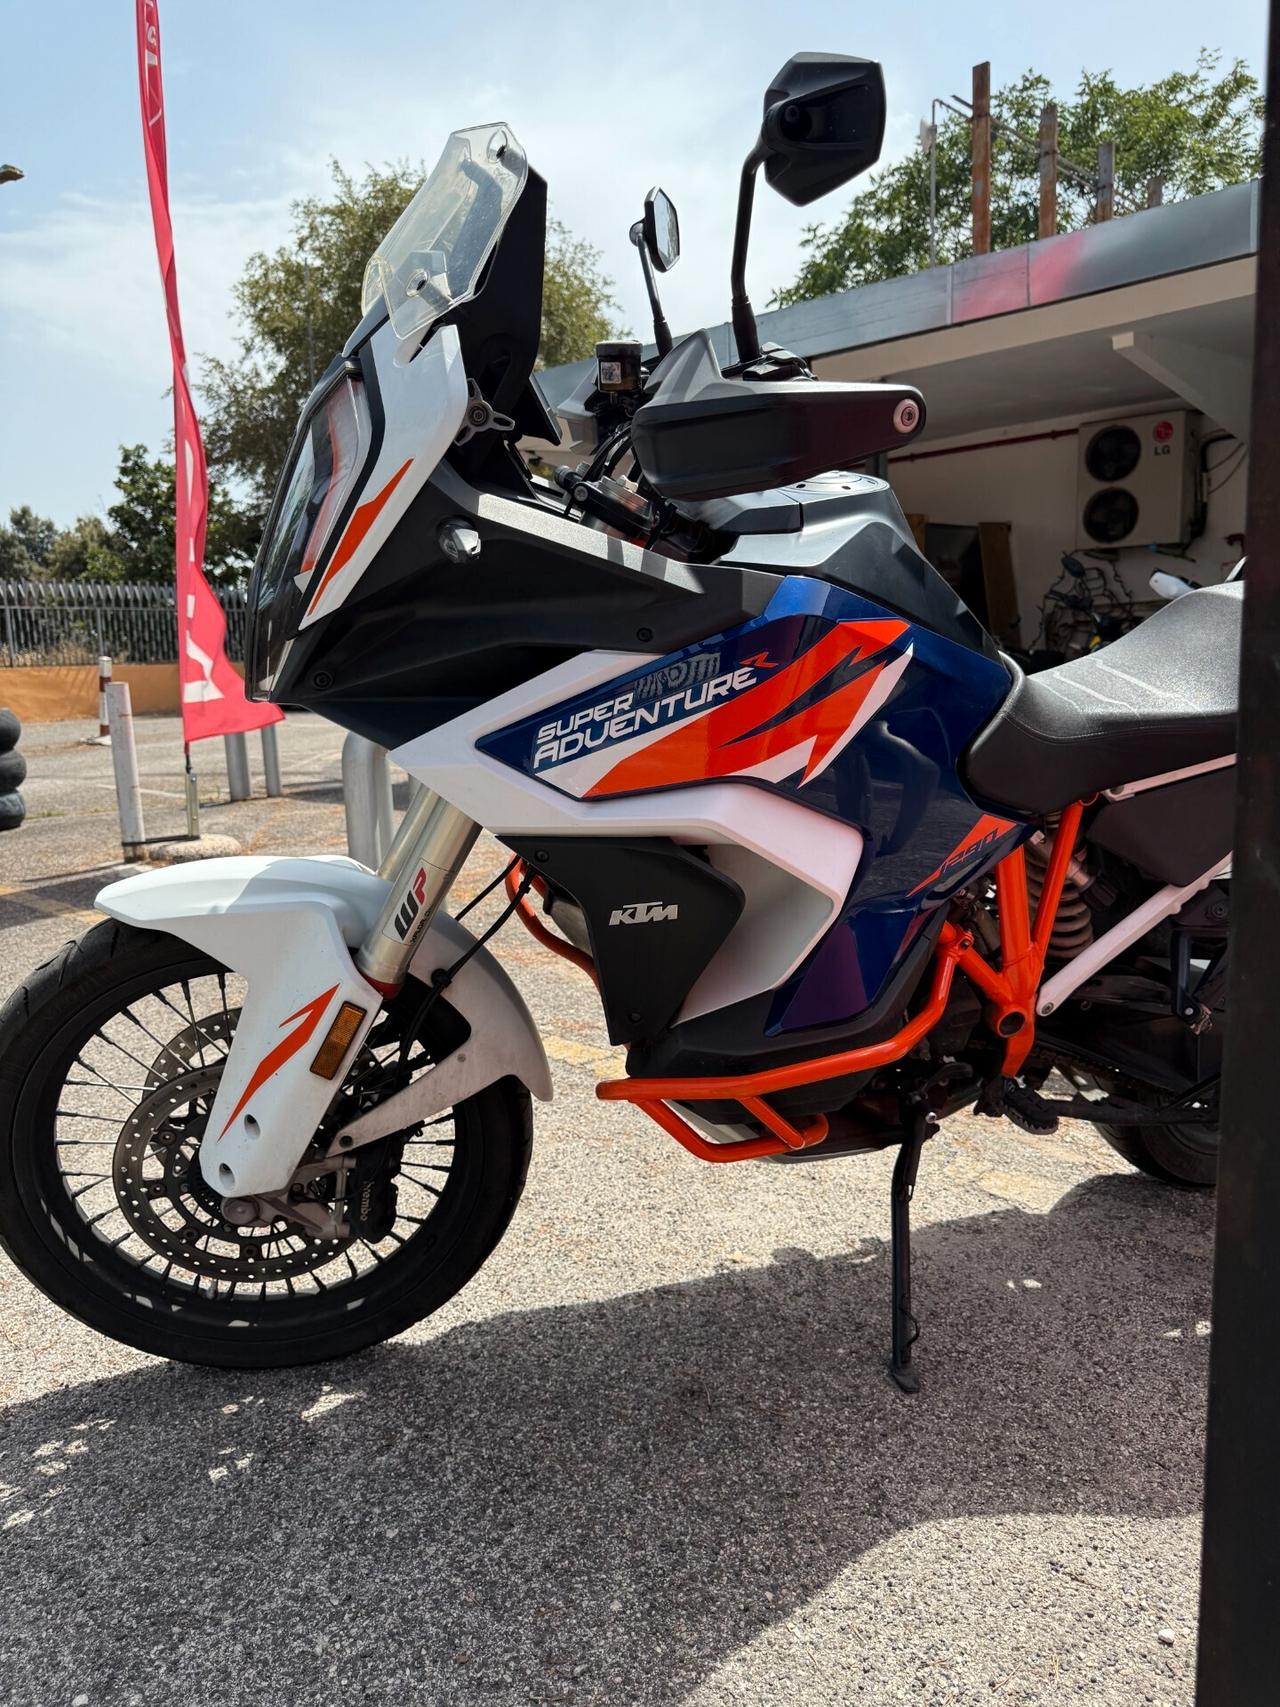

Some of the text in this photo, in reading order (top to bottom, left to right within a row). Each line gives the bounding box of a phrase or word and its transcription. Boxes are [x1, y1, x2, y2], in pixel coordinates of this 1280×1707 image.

[1154, 445, 1171, 457] LG
[533, 667, 758, 769] ADVENTURE
[537, 692, 634, 744] SUPER
[394, 867, 427, 941] WP
[608, 901, 678, 926] KTM
